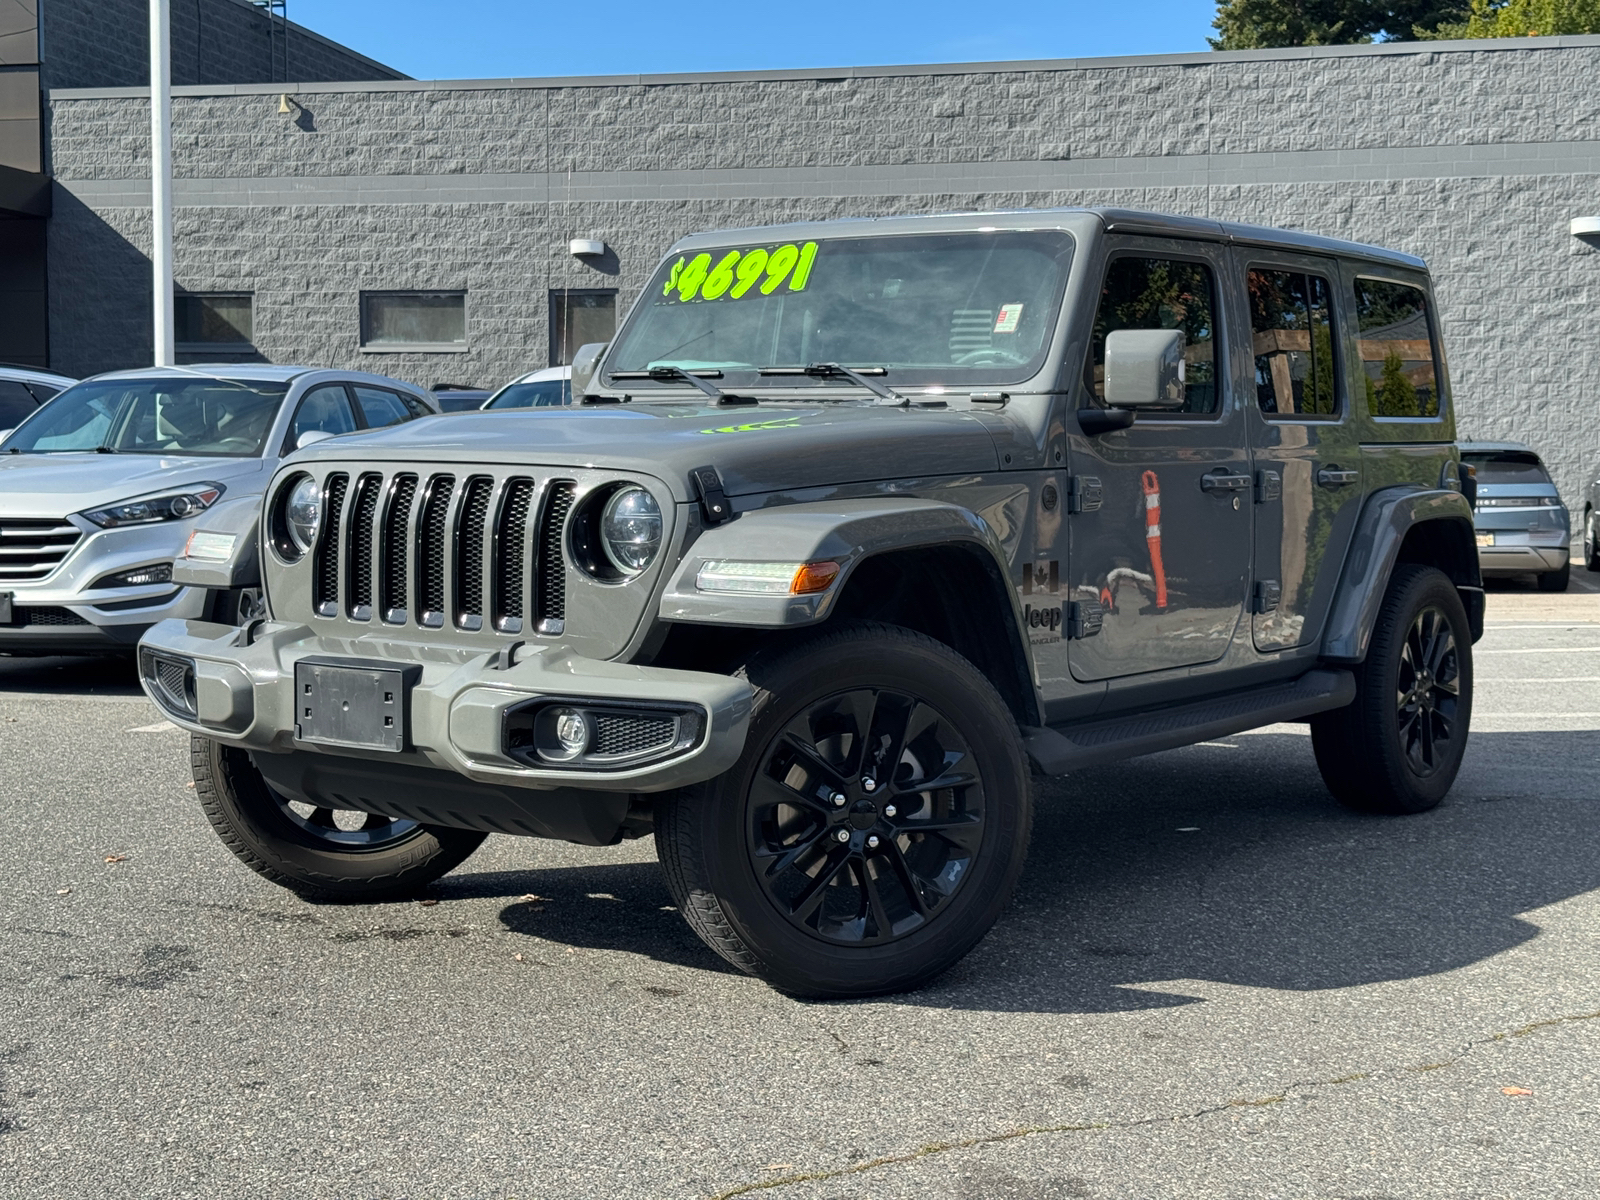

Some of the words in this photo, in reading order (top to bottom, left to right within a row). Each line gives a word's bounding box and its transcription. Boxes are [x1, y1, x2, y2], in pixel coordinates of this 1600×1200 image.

[663, 242, 818, 302] $46991
[1024, 604, 1062, 631] Jeep
[1030, 637, 1060, 645] ANGLER
